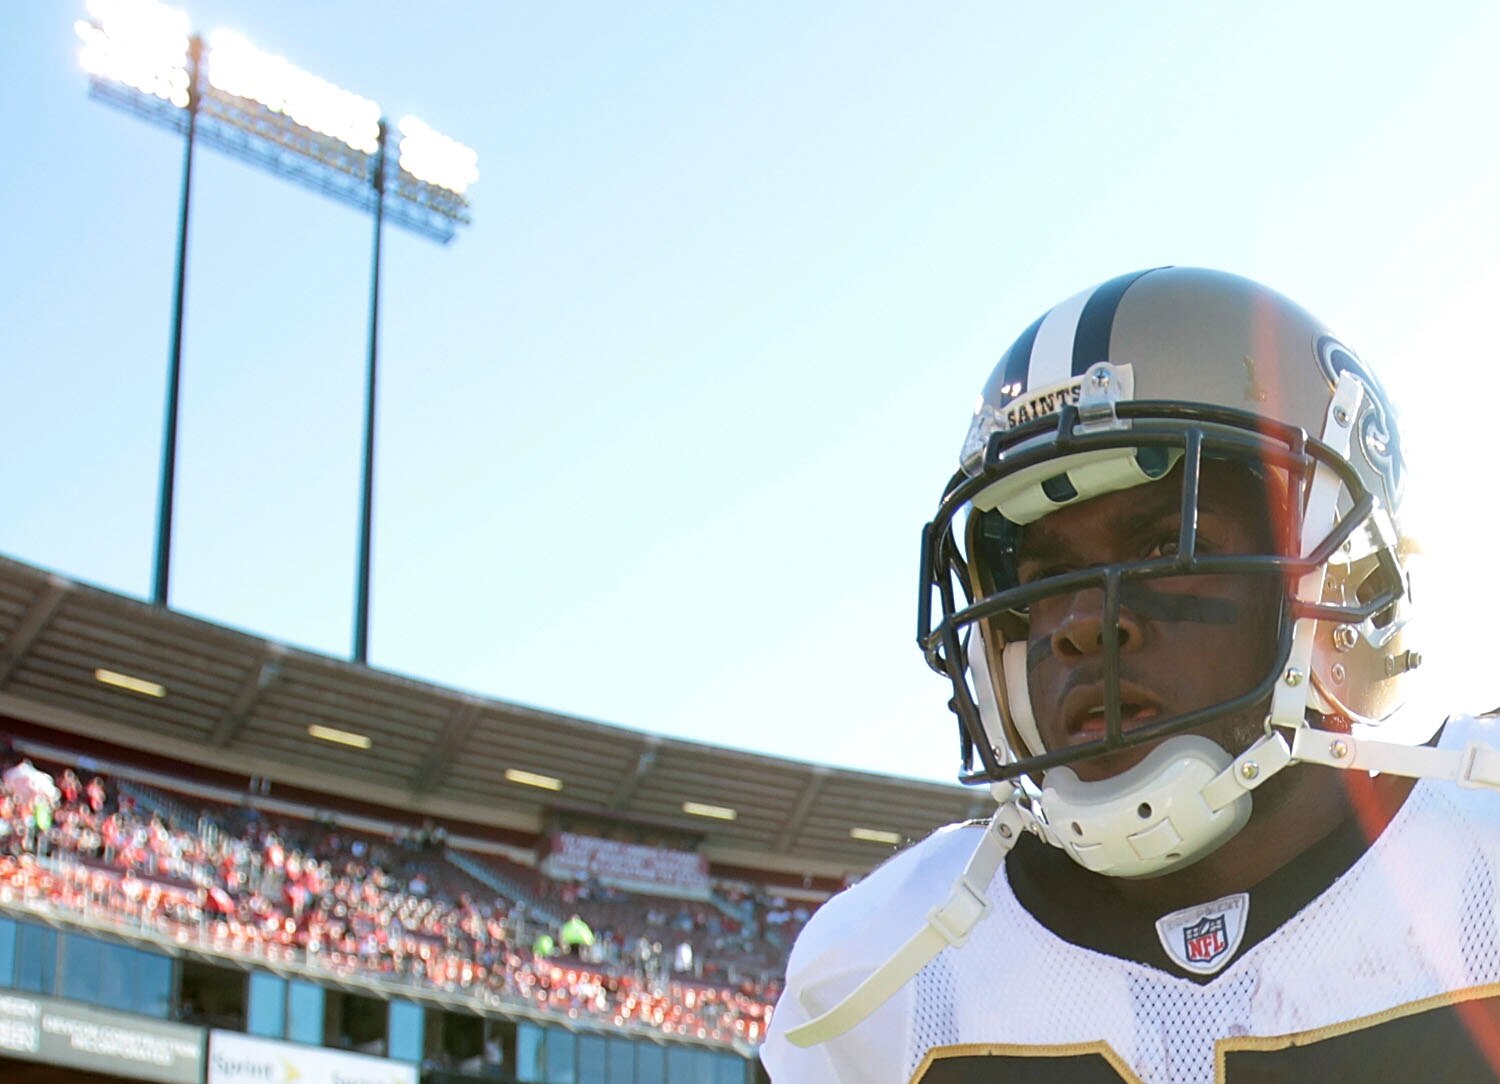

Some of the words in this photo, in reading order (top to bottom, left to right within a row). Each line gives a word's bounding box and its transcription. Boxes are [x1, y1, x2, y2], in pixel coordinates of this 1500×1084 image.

[1007, 384, 1082, 428] SAINTS
[1187, 931, 1225, 959] NFL
[213, 1053, 274, 1081] Sprint
